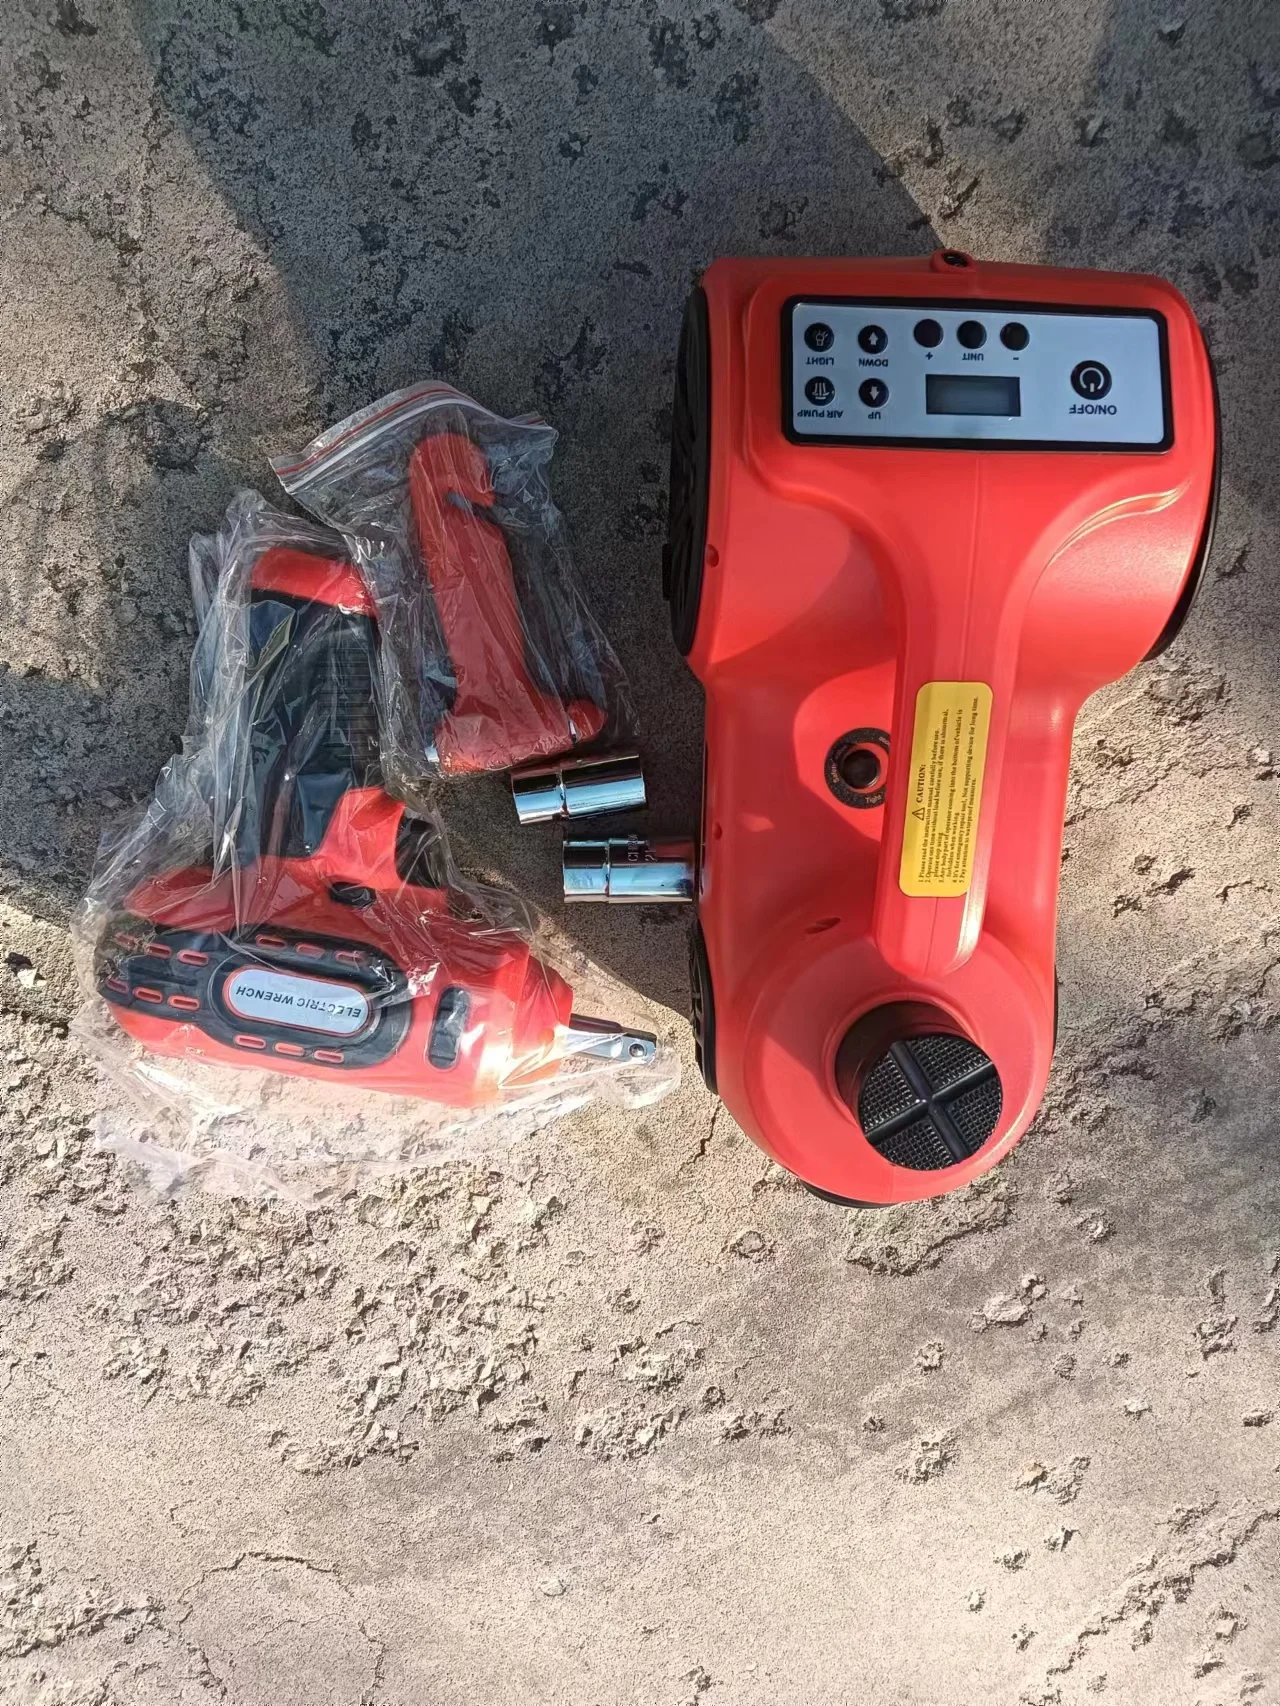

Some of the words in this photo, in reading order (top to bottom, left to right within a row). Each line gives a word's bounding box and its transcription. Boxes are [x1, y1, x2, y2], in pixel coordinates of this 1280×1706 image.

[805, 357, 834, 366] LIGHT
[858, 358, 889, 367] DOWN
[962, 353, 984, 361] UNIT
[797, 409, 825, 418] PUMP
[826, 410, 844, 419] AIR
[867, 411, 881, 420] UP
[1069, 404, 1118, 416] ON/OFF
[954, 716, 962, 737] vehicle
[930, 741, 938, 760] before
[959, 812, 967, 829] repair
[964, 756, 973, 786] supporting
[970, 712, 978, 725] long
[916, 764, 926, 803] CAUTION:
[926, 787, 934, 807] manual
[947, 788, 956, 809] coming
[923, 808, 931, 837] instruction
[930, 811, 938, 832] without
[945, 810, 953, 833] operator
[964, 806, 975, 836] waterproof
[940, 853, 948, 866] body
[946, 851, 954, 877] forbidden
[961, 843, 969, 867] attention
[236, 986, 294, 1005] WRENCH
[296, 998, 362, 1018] ELECTRIC
